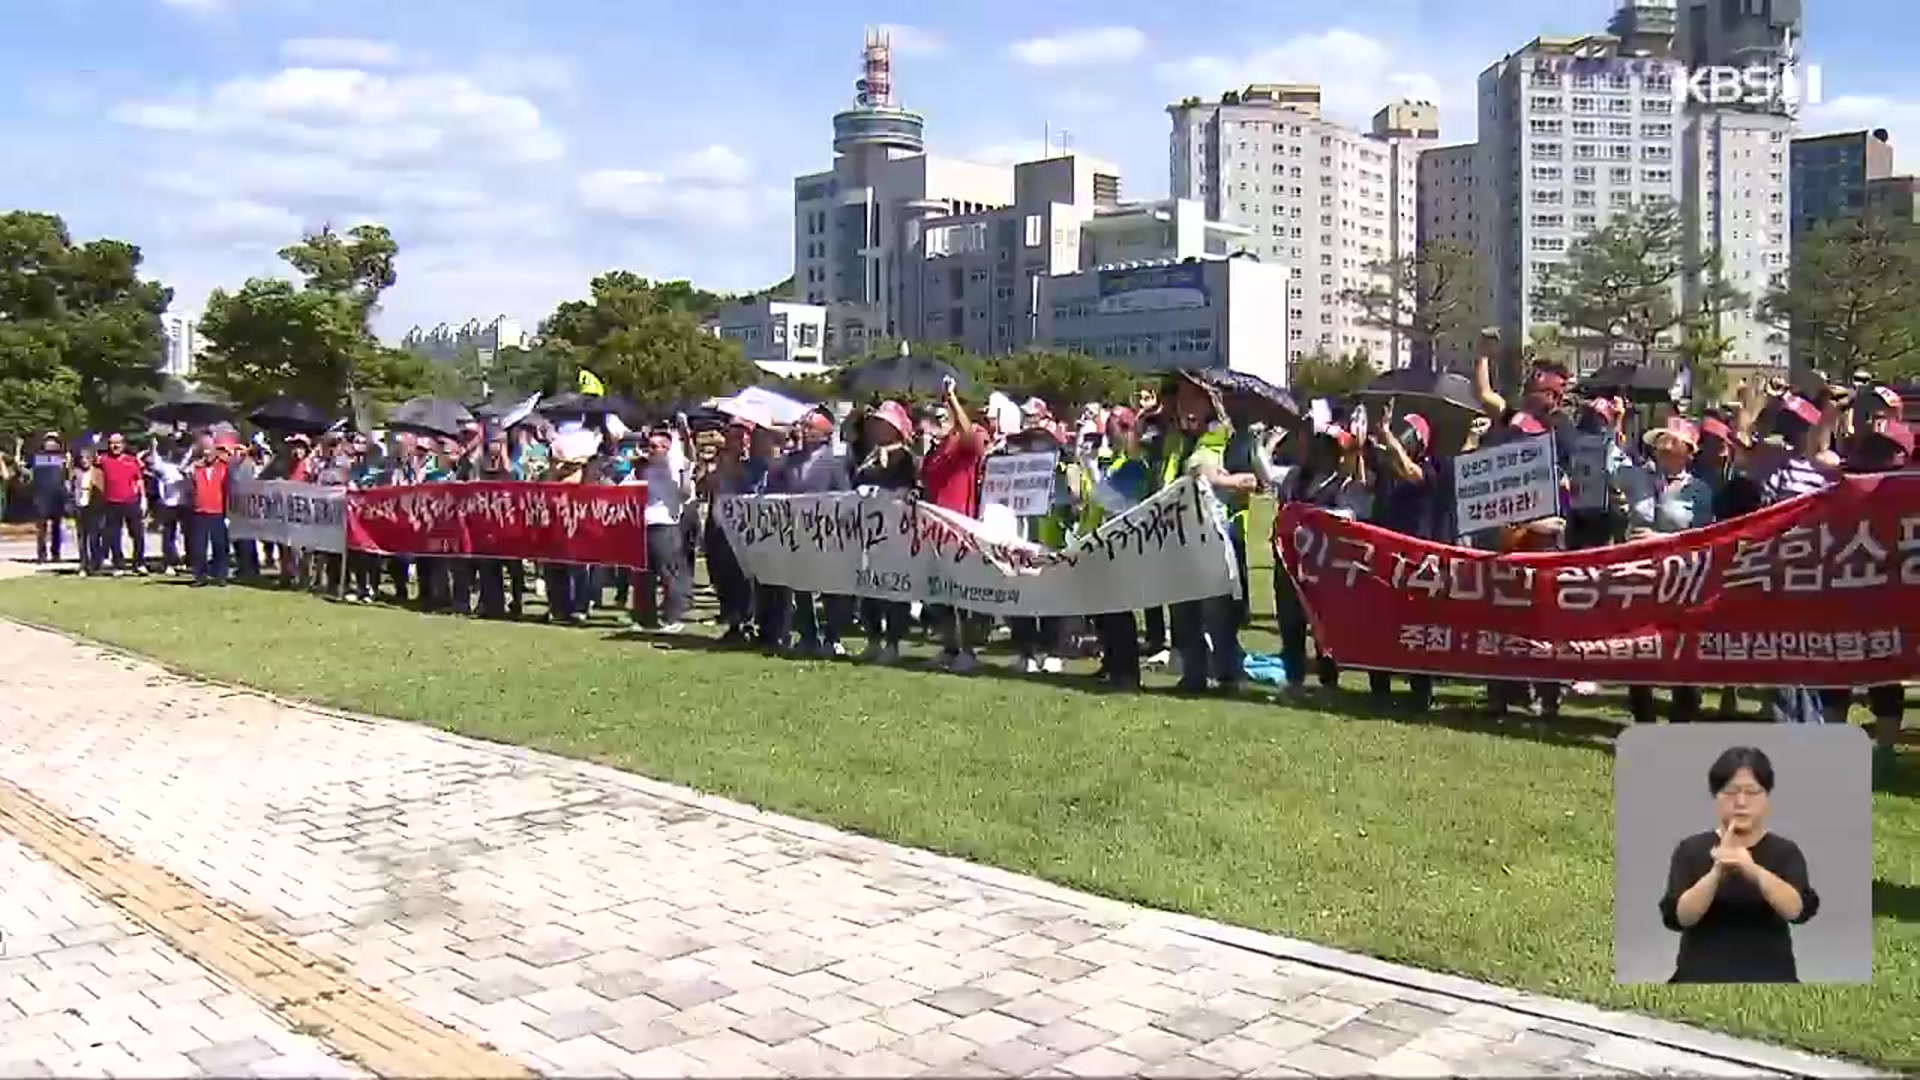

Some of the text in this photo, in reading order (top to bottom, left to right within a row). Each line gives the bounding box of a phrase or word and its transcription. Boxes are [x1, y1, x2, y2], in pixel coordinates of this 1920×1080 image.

[801, 500, 888, 551] 막아내고
[1467, 491, 1537, 520] 각성하라!
[1292, 521, 1376, 587] 인구
[1556, 544, 1714, 611] 광주에
[1398, 623, 1451, 652] 주최
[1697, 627, 1902, 662] 전남상인연합회
